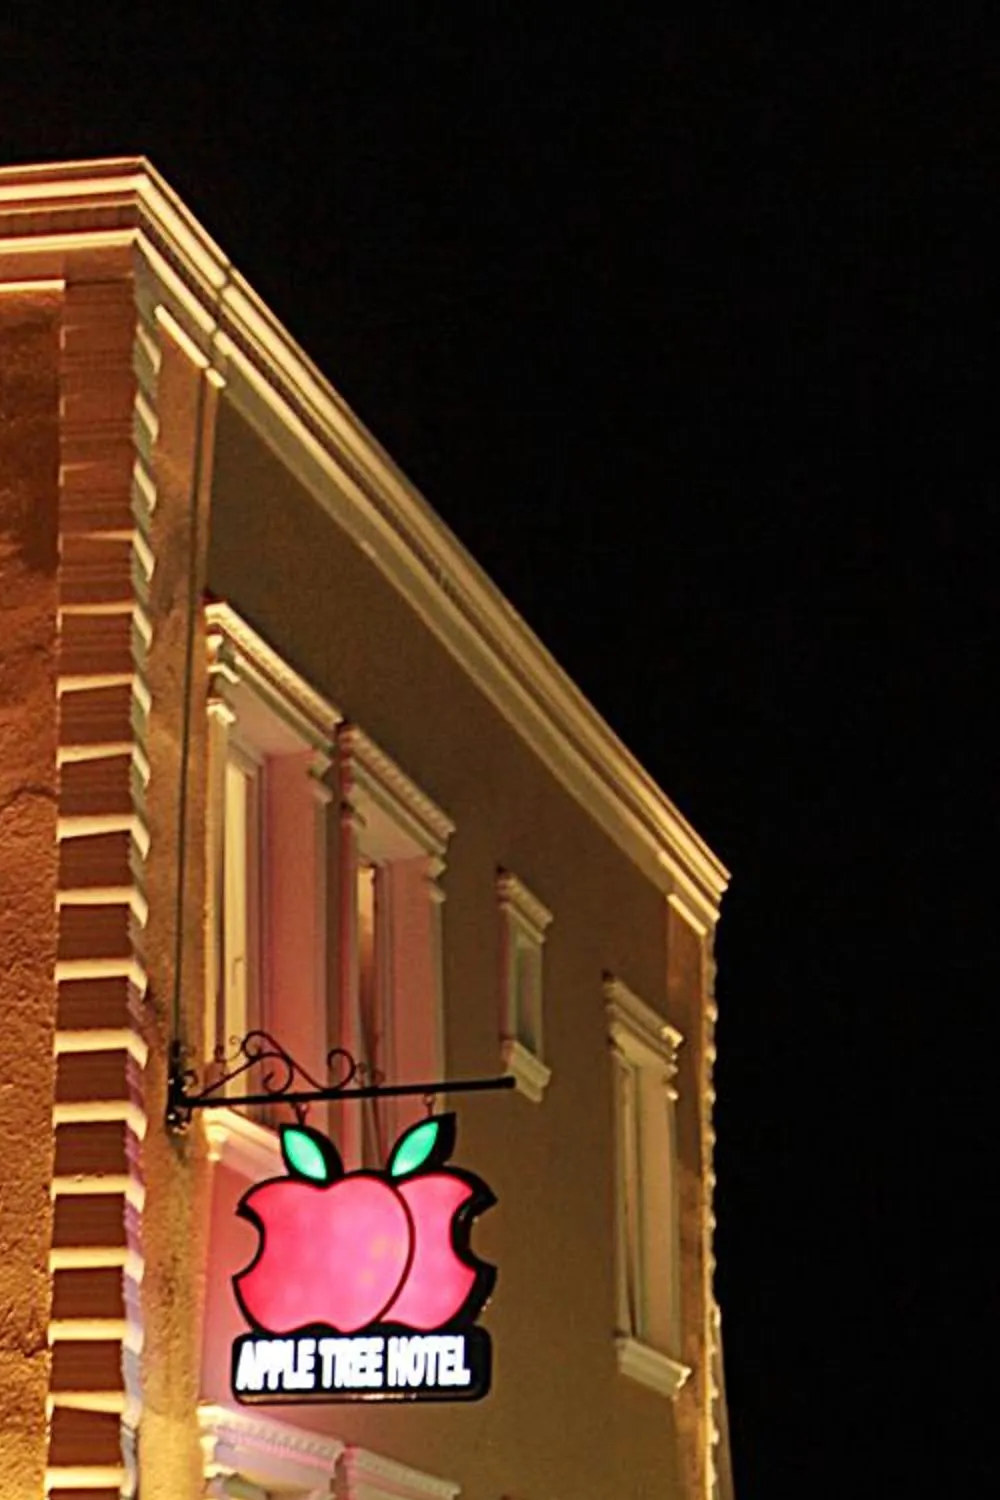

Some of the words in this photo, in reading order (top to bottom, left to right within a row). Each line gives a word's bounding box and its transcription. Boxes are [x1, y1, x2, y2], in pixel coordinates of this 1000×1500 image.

[235, 1339, 316, 1391] APPLE
[318, 1336, 385, 1389] TREE
[387, 1335, 471, 1387] HOTEL
